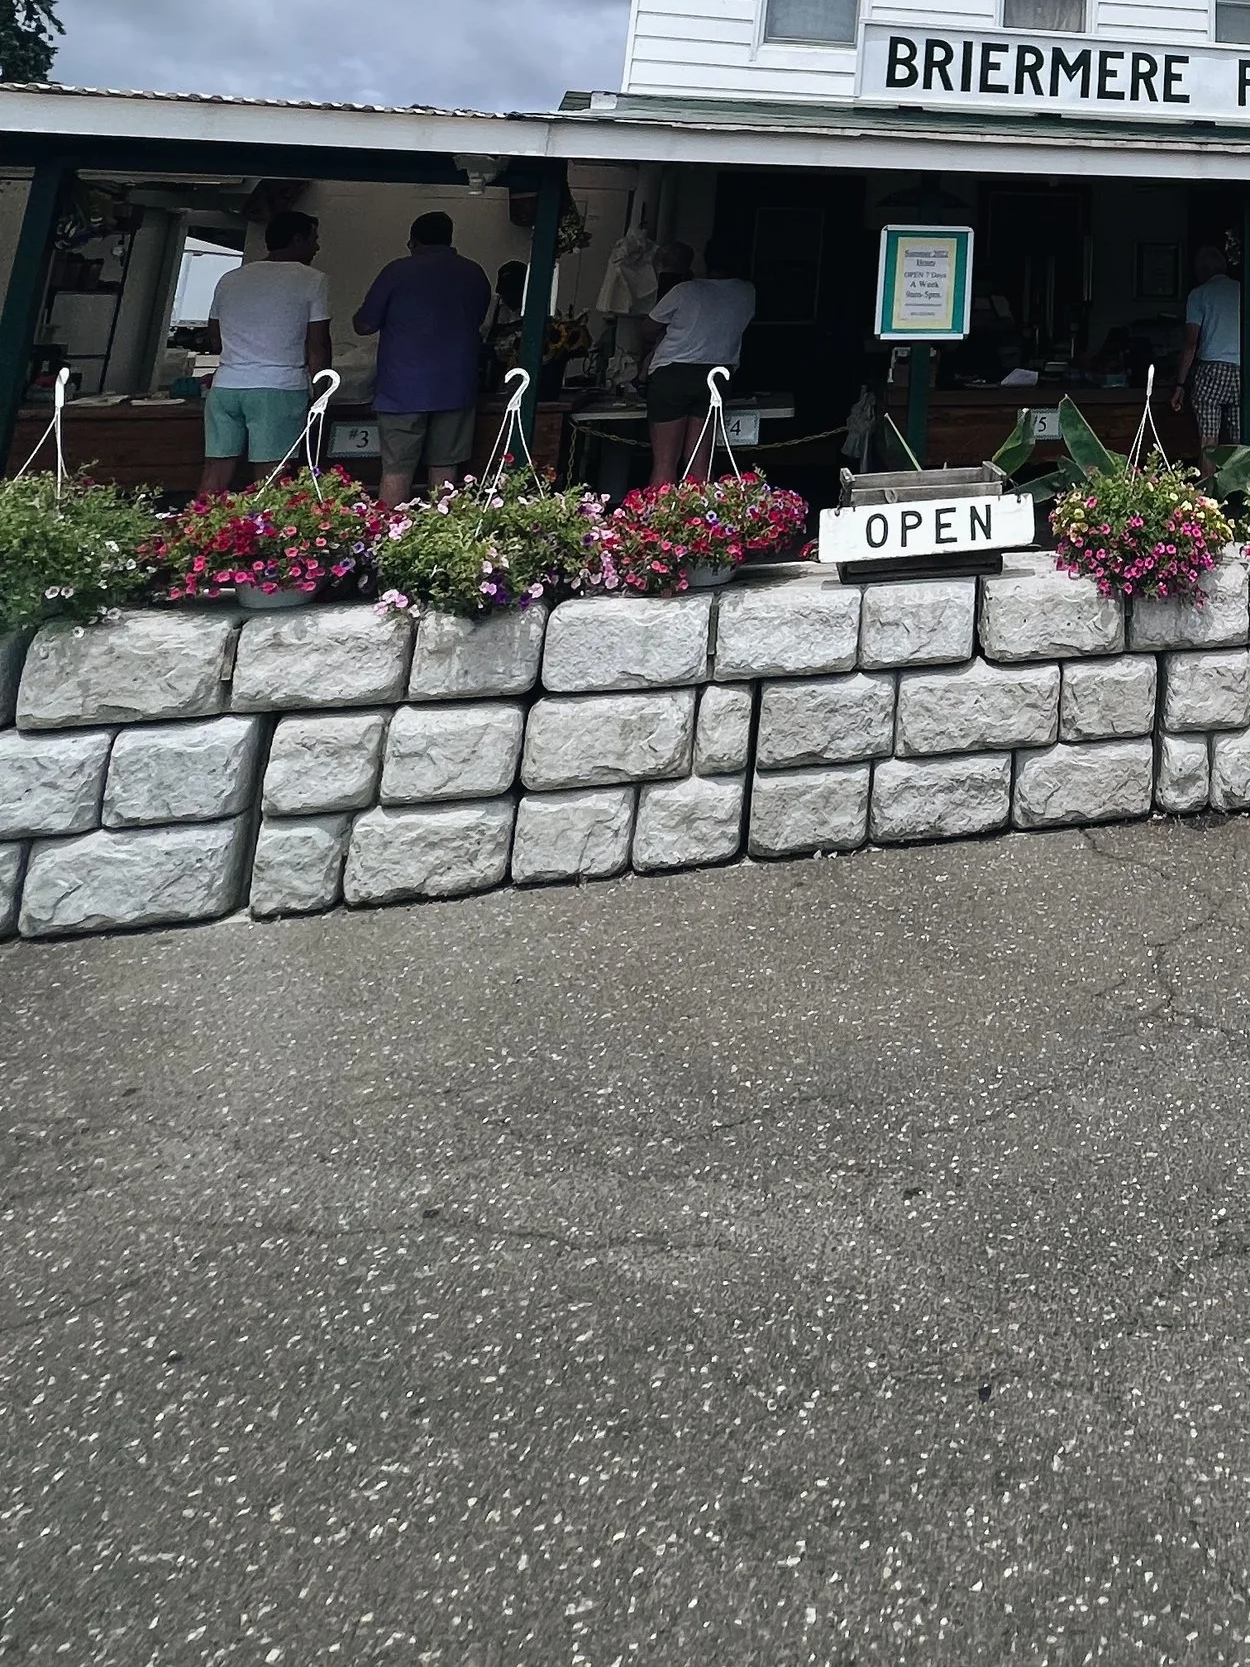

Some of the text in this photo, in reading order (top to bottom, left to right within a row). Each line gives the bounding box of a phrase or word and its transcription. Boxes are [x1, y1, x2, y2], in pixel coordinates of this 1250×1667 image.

[886, 36, 1190, 104] BRIERMERE
[349, 428, 369, 448] #3
[866, 504, 992, 548] OPEN
